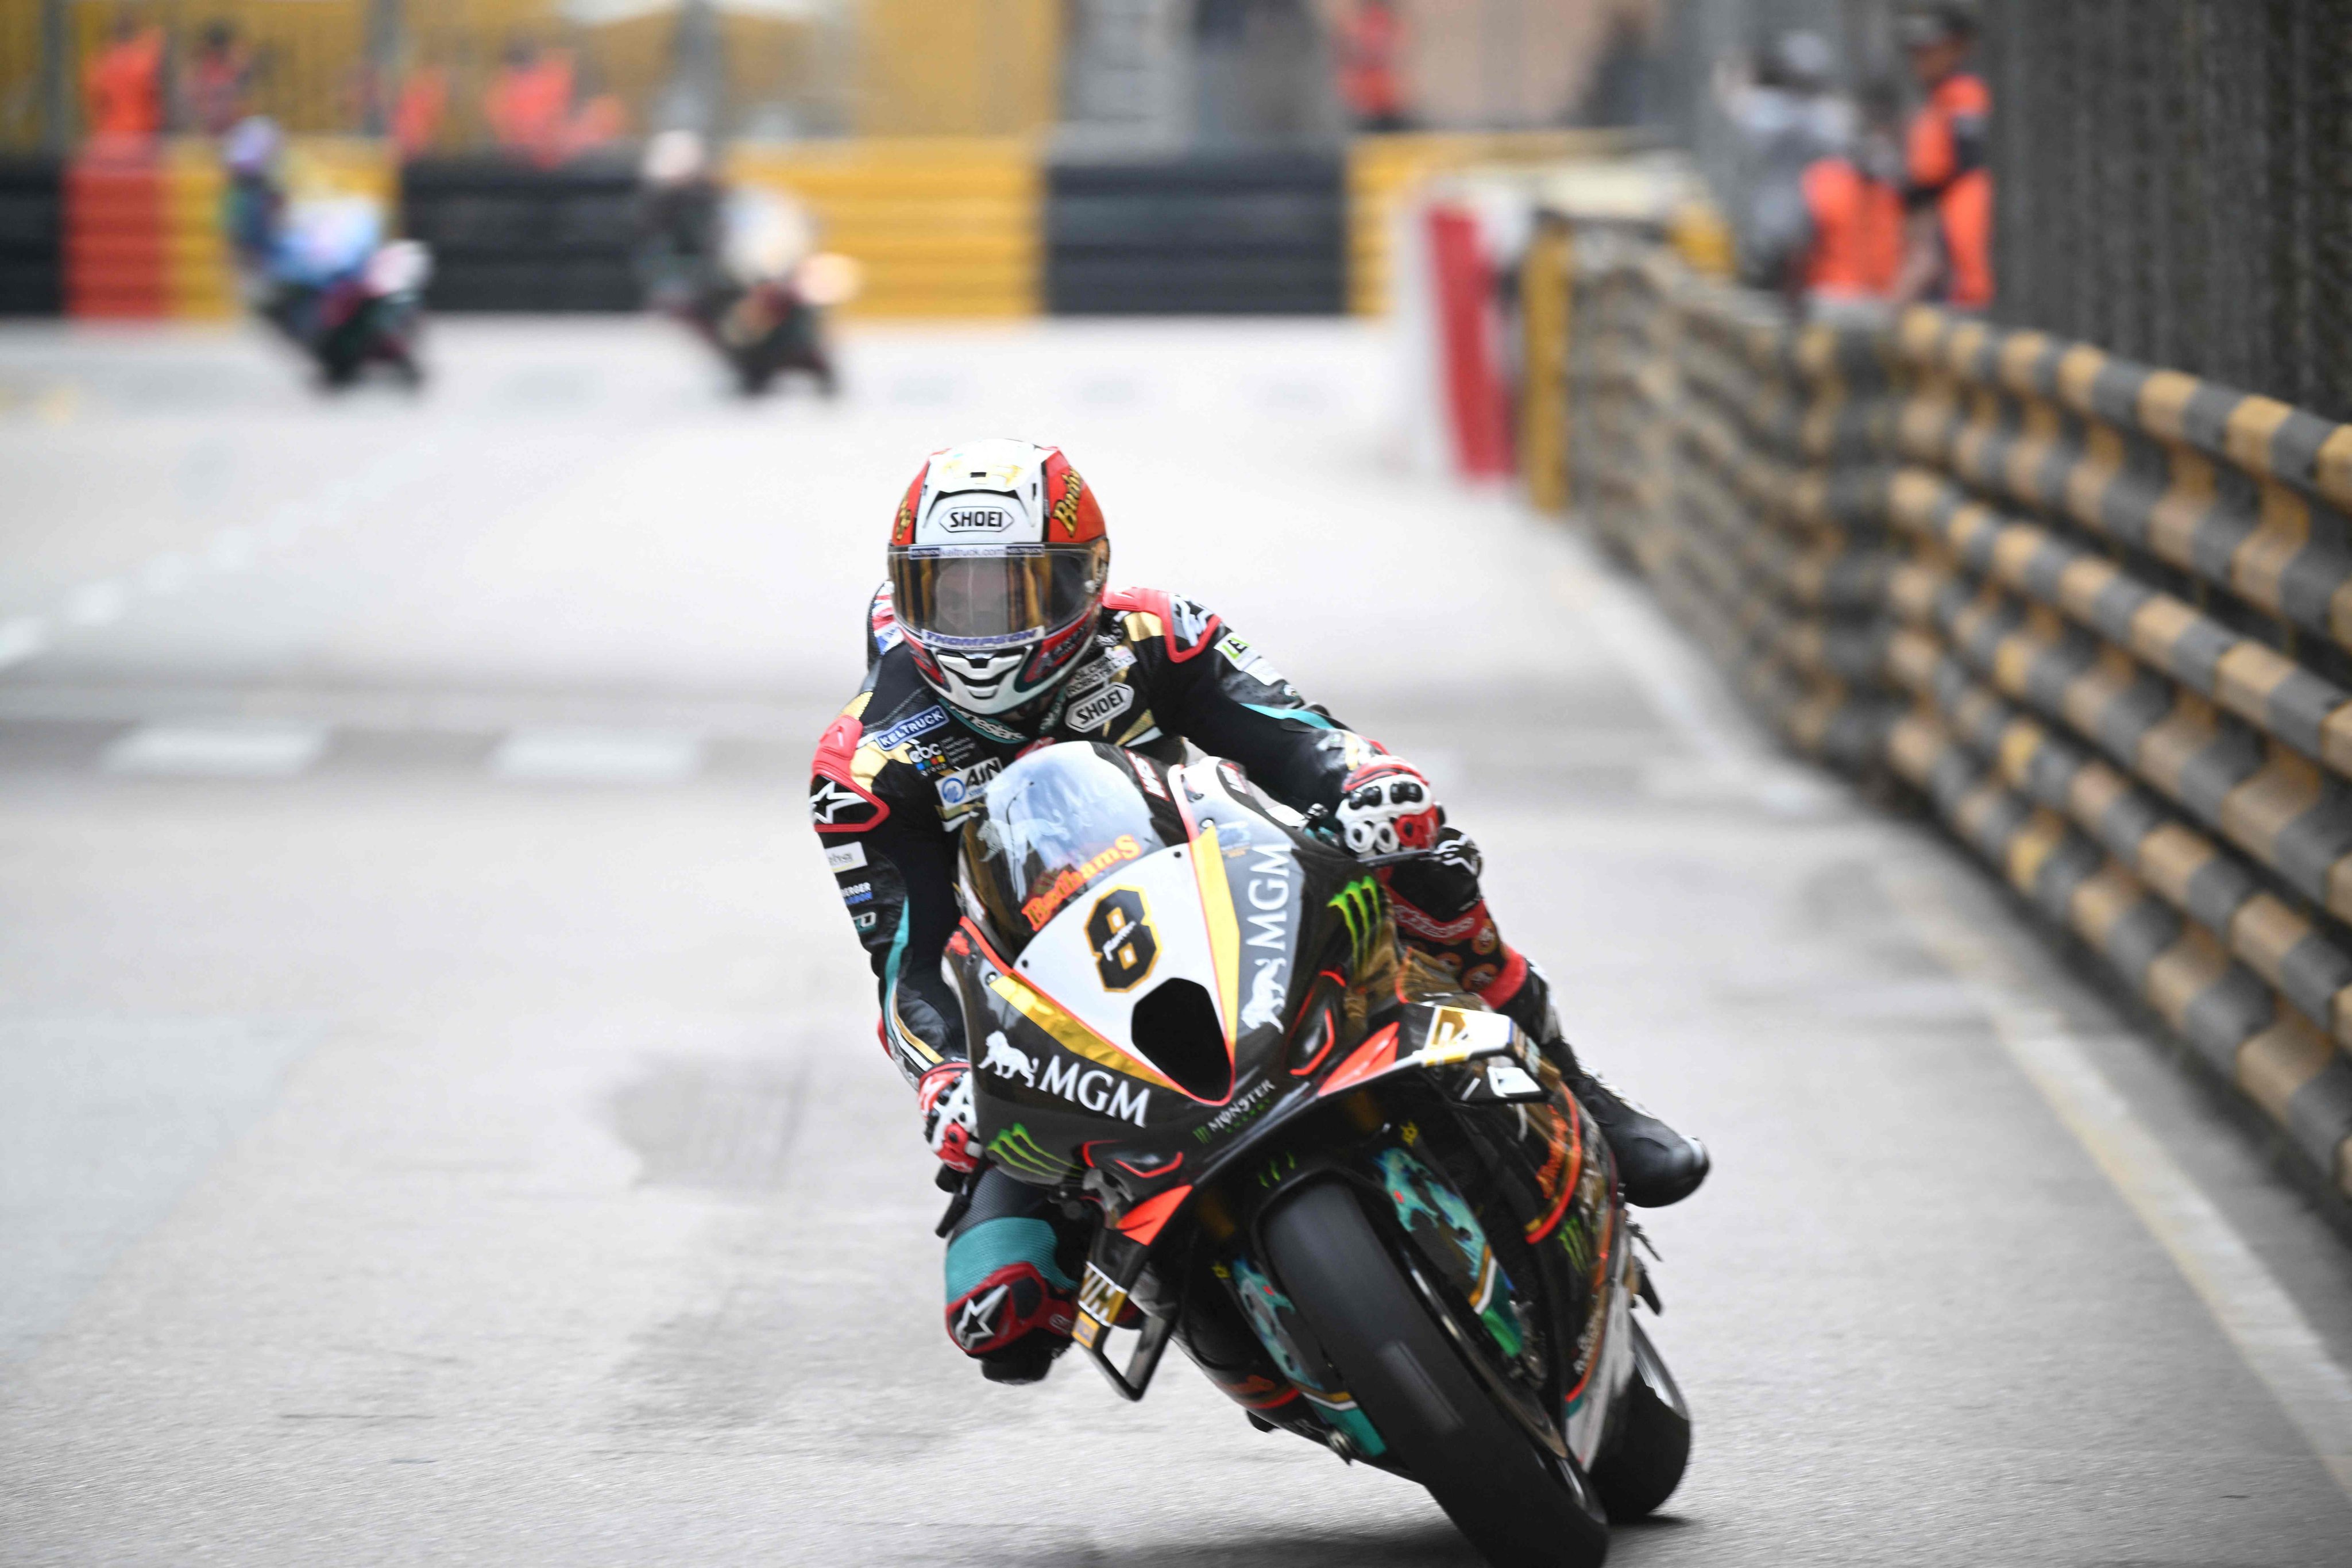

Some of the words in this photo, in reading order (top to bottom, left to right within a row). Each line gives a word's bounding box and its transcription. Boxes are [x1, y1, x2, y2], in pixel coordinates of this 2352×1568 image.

[950, 511, 1002, 528] SHOEI
[1076, 689, 1124, 724] SHOEI
[879, 710, 944, 746] KELTRUCK
[909, 743, 942, 763] ebc
[966, 760, 1001, 787] AJN
[1245, 843, 1292, 952] MGM
[1084, 885, 1163, 992] 8
[1037, 1055, 1150, 1129] MGM
[1207, 1079, 1276, 1133] MONSTER
